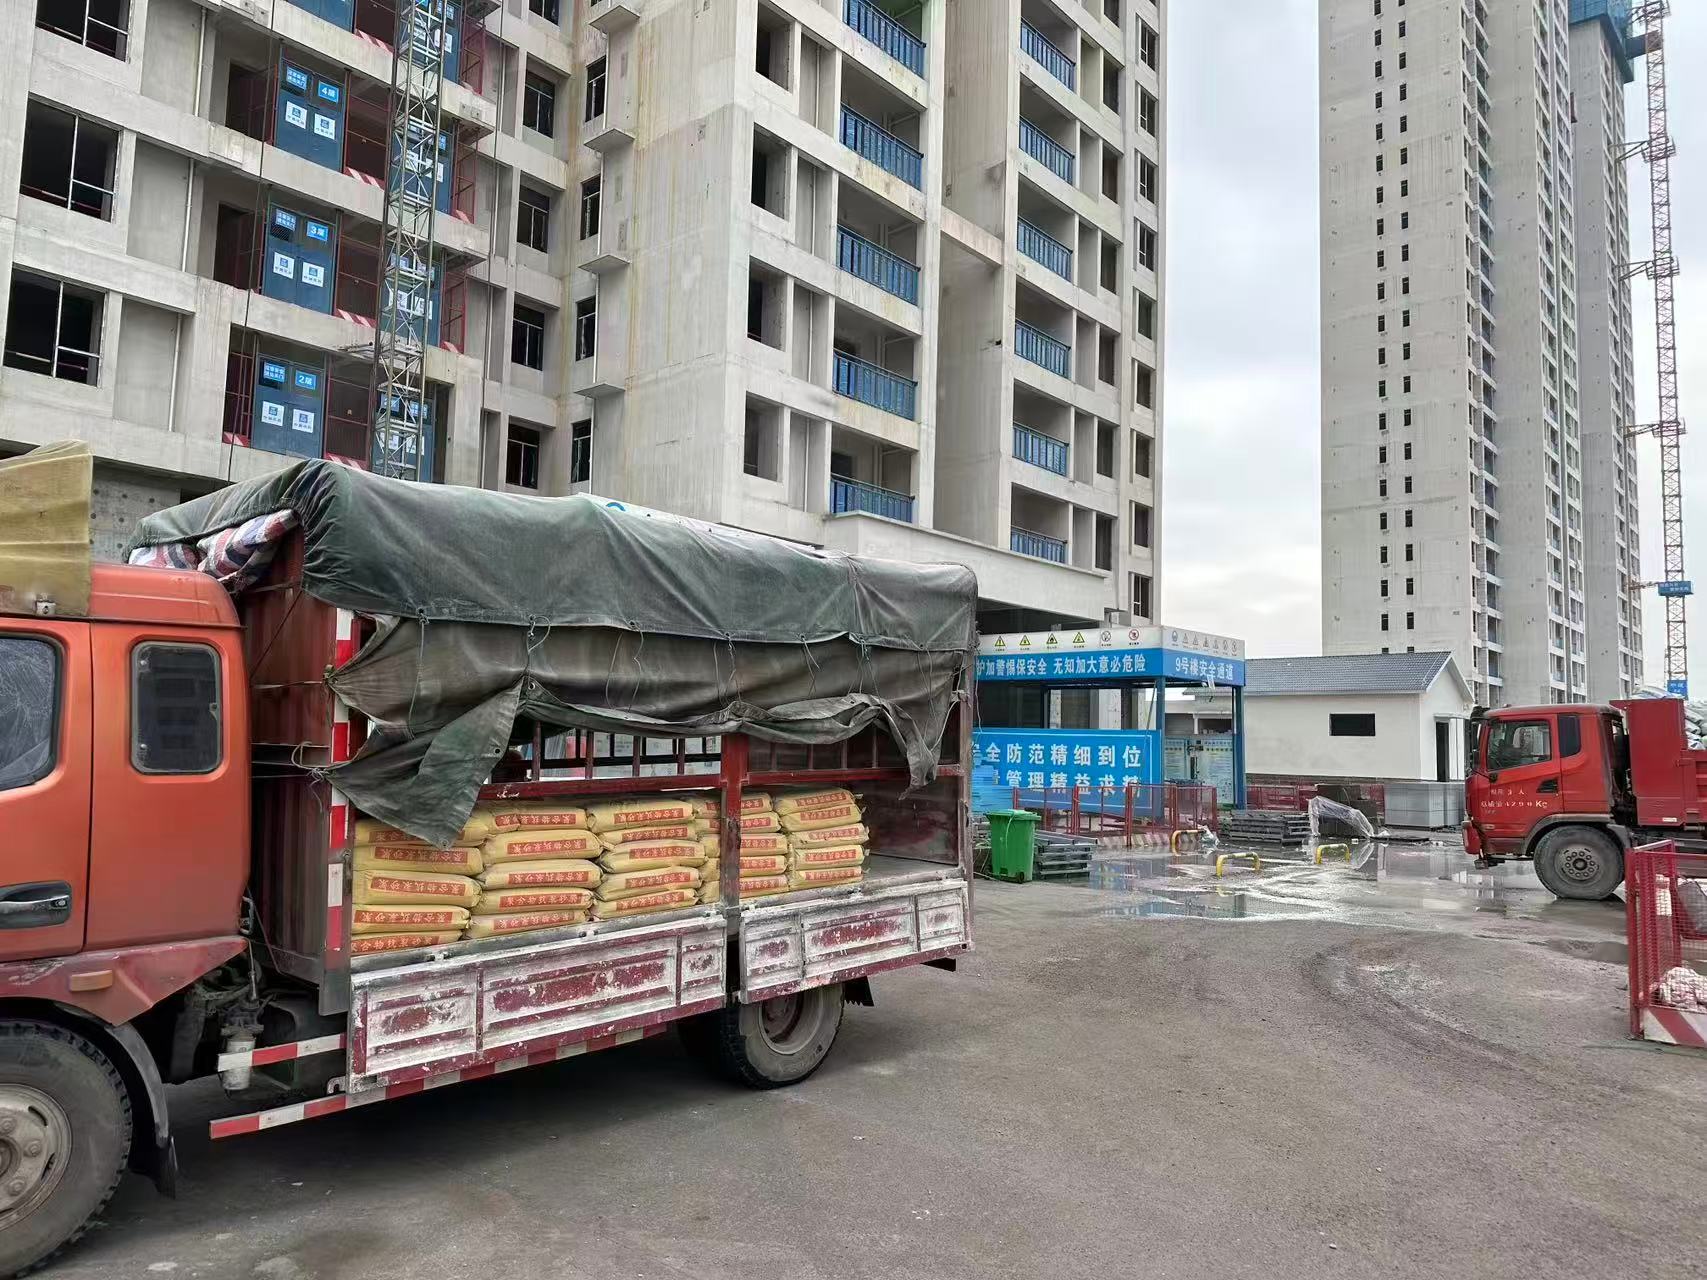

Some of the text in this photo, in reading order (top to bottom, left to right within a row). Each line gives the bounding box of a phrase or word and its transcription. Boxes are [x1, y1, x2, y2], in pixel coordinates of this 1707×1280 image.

[1053, 653, 1146, 674] 无知加大意必危险
[1175, 656, 1234, 680] 9号楼安全通道
